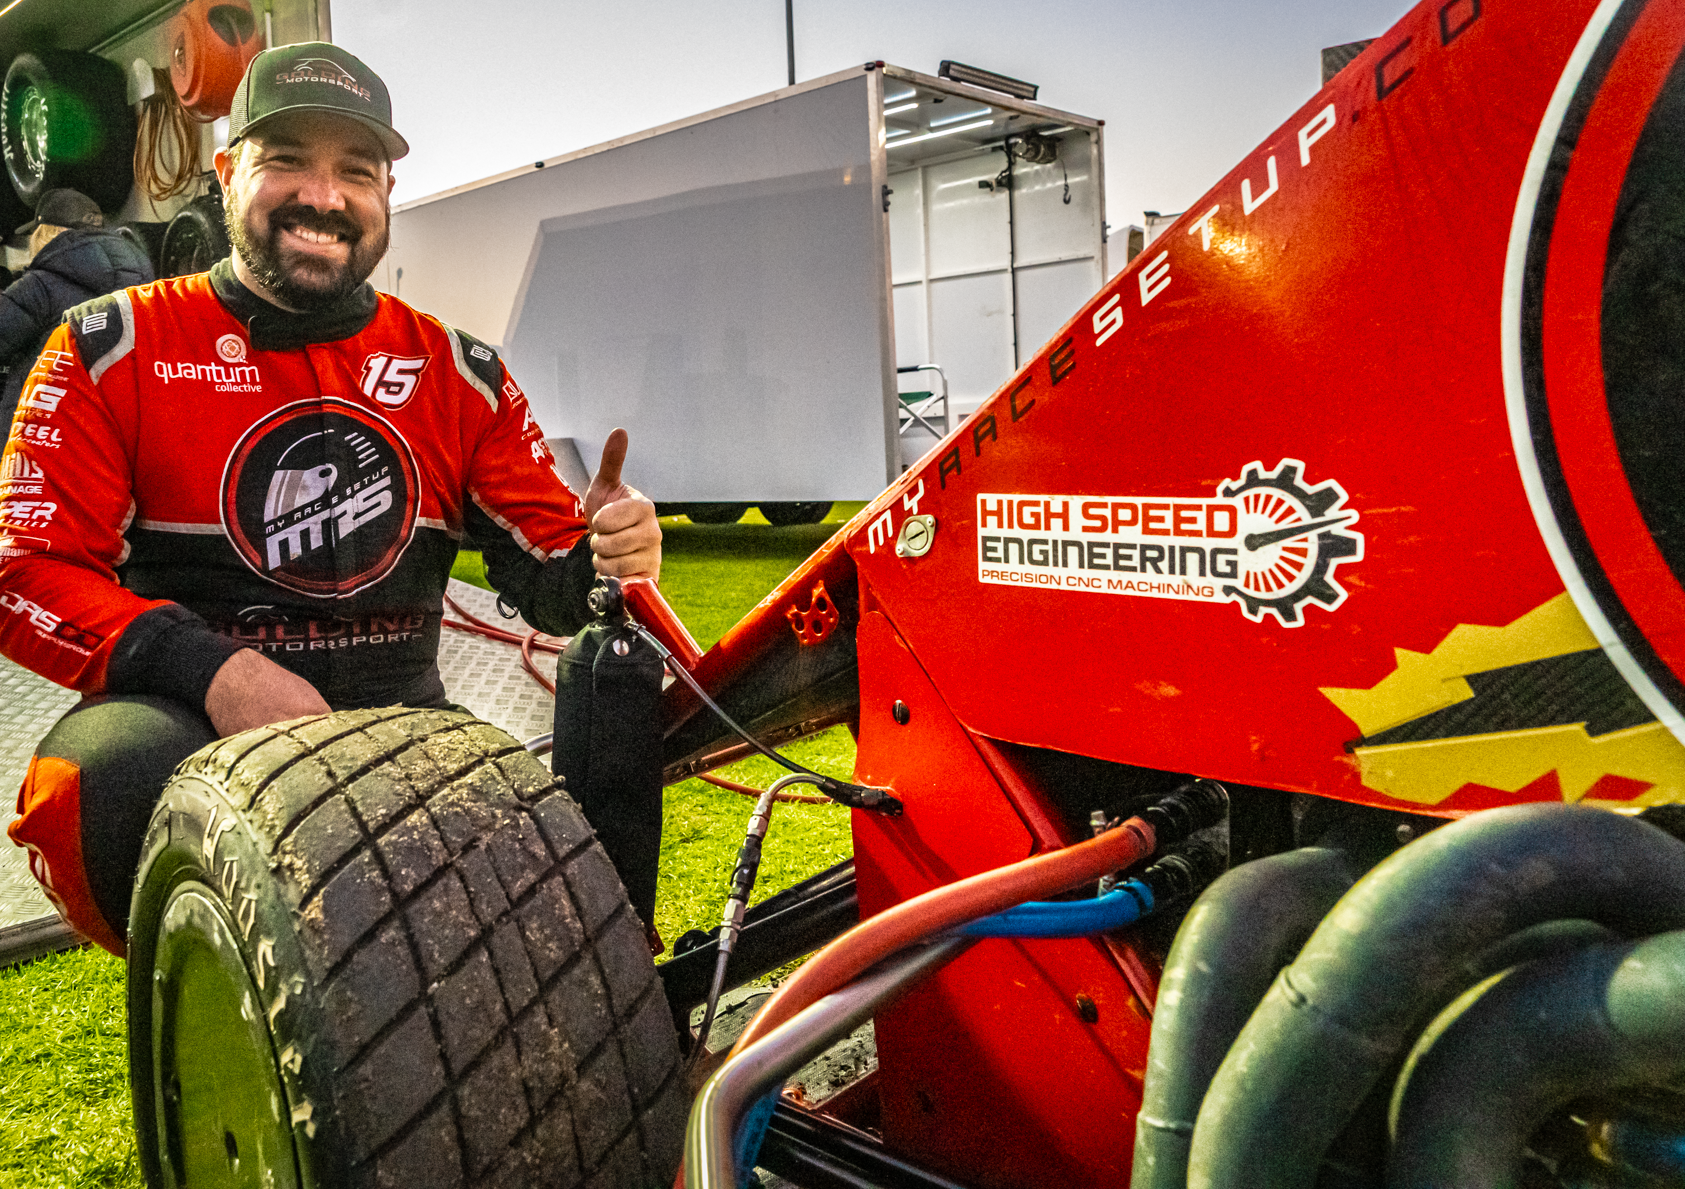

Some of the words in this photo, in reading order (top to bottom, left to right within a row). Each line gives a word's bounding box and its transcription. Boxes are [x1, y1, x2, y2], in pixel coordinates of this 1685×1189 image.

[153, 360, 261, 385] quantum
[214, 381, 263, 394] collective
[361, 354, 428, 407] 15
[345, 464, 389, 497] SETUP
[979, 498, 1070, 533] HIGH
[1080, 500, 1239, 539] SPEED
[980, 534, 1239, 580] ENGINEERING
[981, 569, 1063, 588] PRECISION
[1065, 574, 1103, 590] CNC
[1106, 578, 1216, 599] MACHINING
